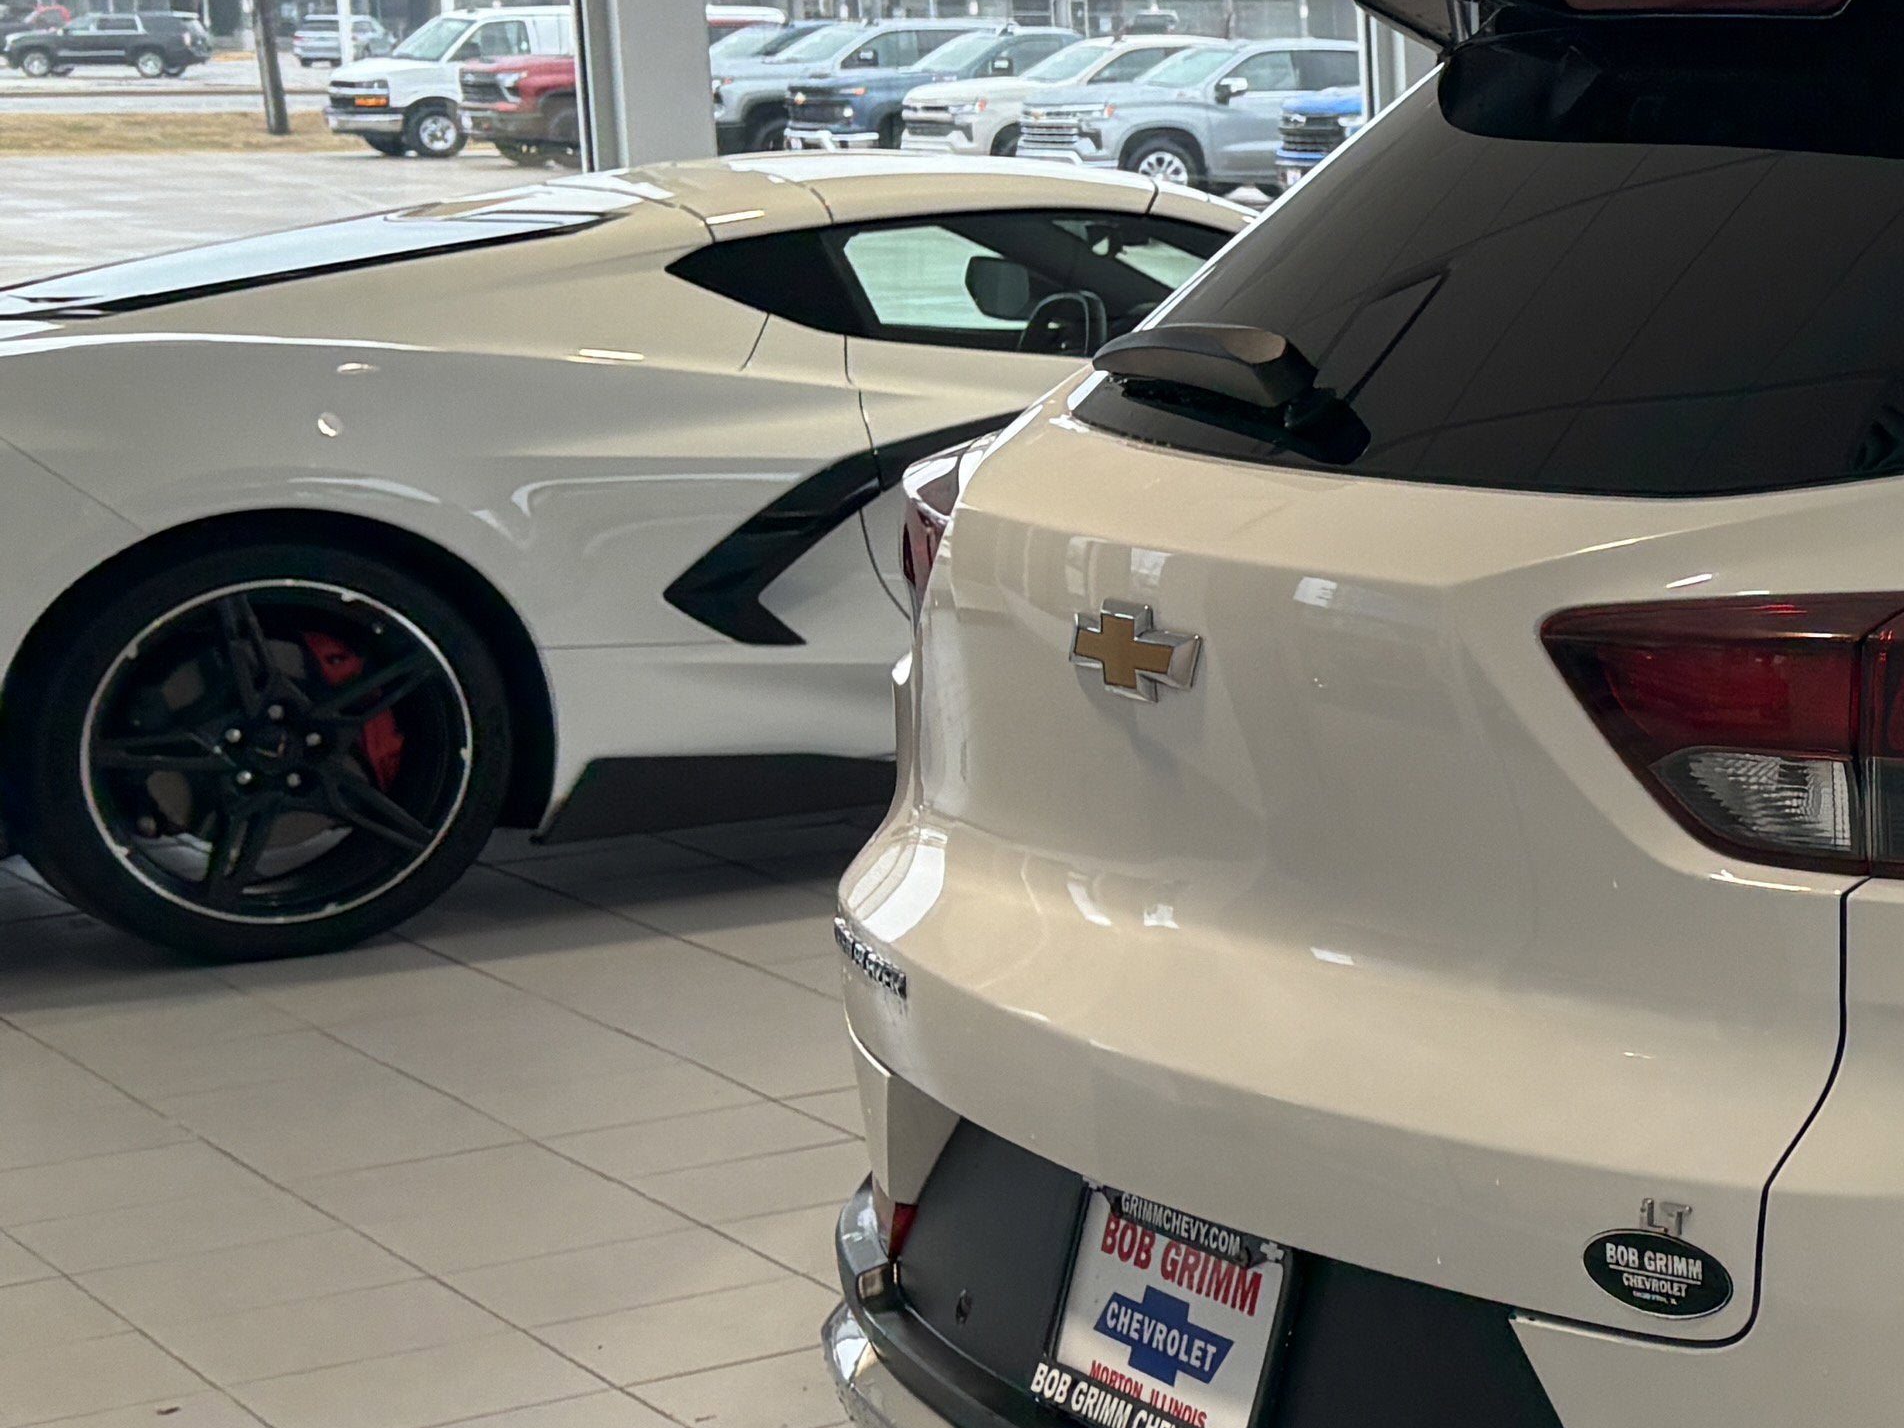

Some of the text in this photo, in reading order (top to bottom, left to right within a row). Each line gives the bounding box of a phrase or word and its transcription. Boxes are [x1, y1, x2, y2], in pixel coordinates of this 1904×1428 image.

[1120, 1192, 1242, 1257] GRIMMCHEVY.COM
[1639, 1197, 1692, 1236] LT
[1101, 1212, 1263, 1318] BOB GRIMM
[1605, 1242, 1703, 1281] BOB GRIMM
[1622, 1272, 1688, 1298] CHEVROLET
[1106, 1301, 1217, 1372] CHEVROLET
[1030, 1362, 1072, 1405] BOB
[1088, 1359, 1208, 1428] MORTON ILLINOIS
